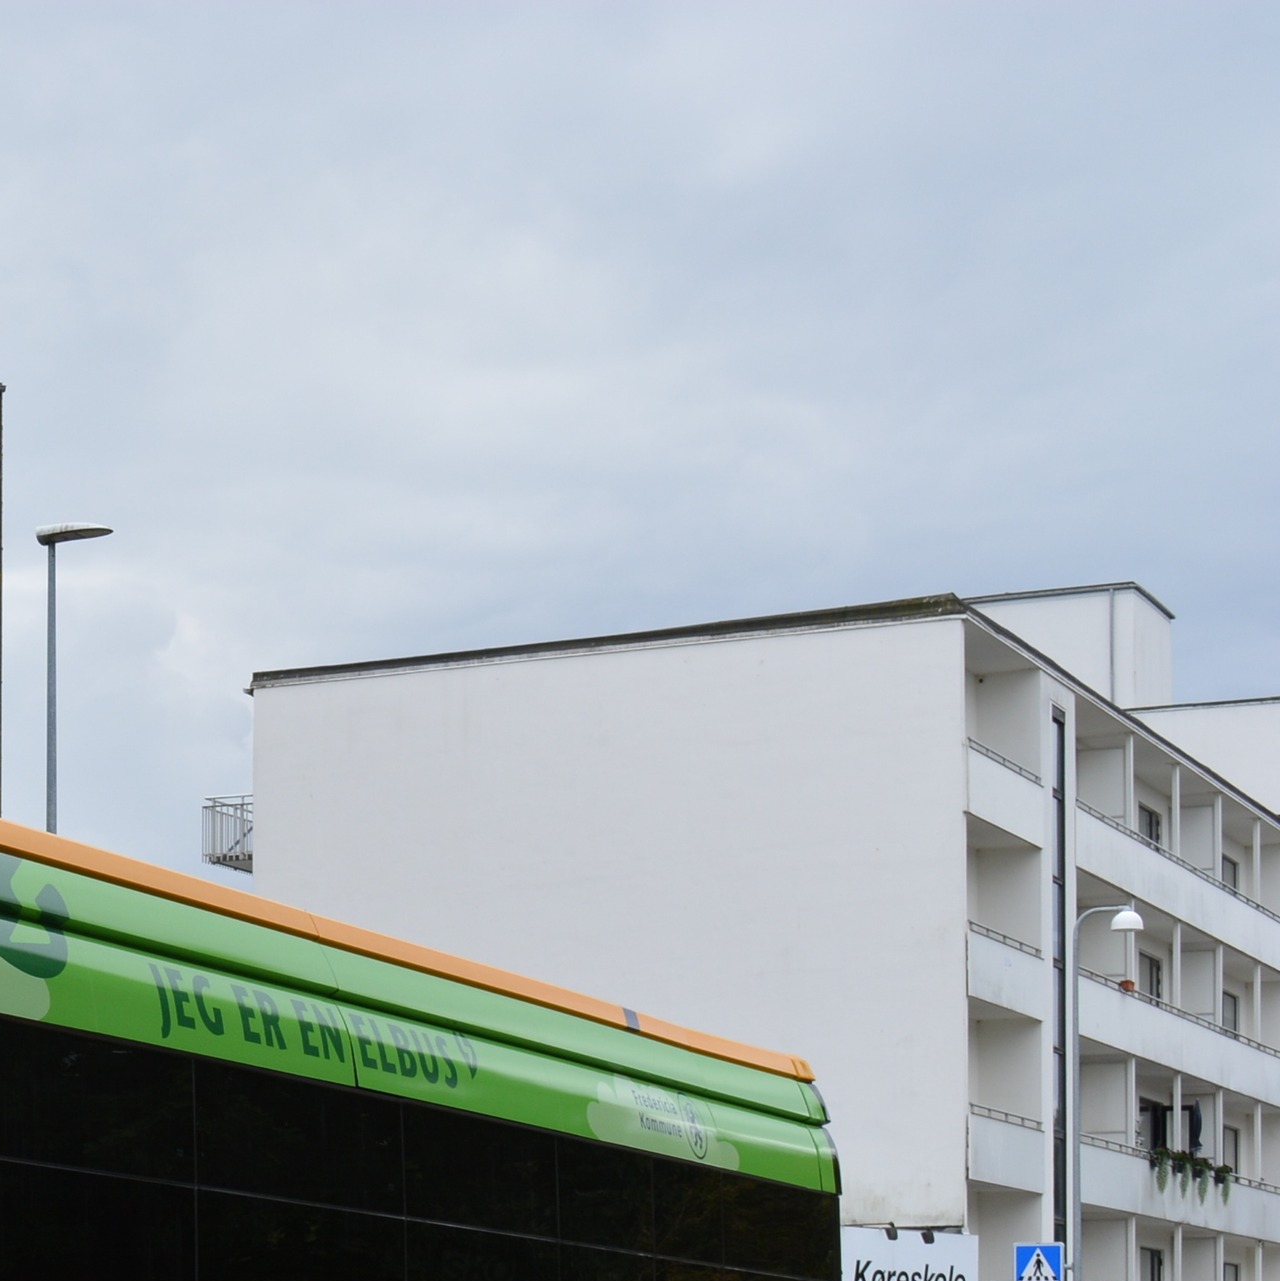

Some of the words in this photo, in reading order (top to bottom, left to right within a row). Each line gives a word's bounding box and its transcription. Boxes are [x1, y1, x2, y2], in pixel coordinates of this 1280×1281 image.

[148, 962, 225, 1038] JEG
[237, 984, 287, 1051] ER
[290, 999, 346, 1063] EN
[351, 1015, 464, 1089] ELBUS
[631, 1089, 678, 1115] Fredericia
[639, 1111, 682, 1138] Kommune
